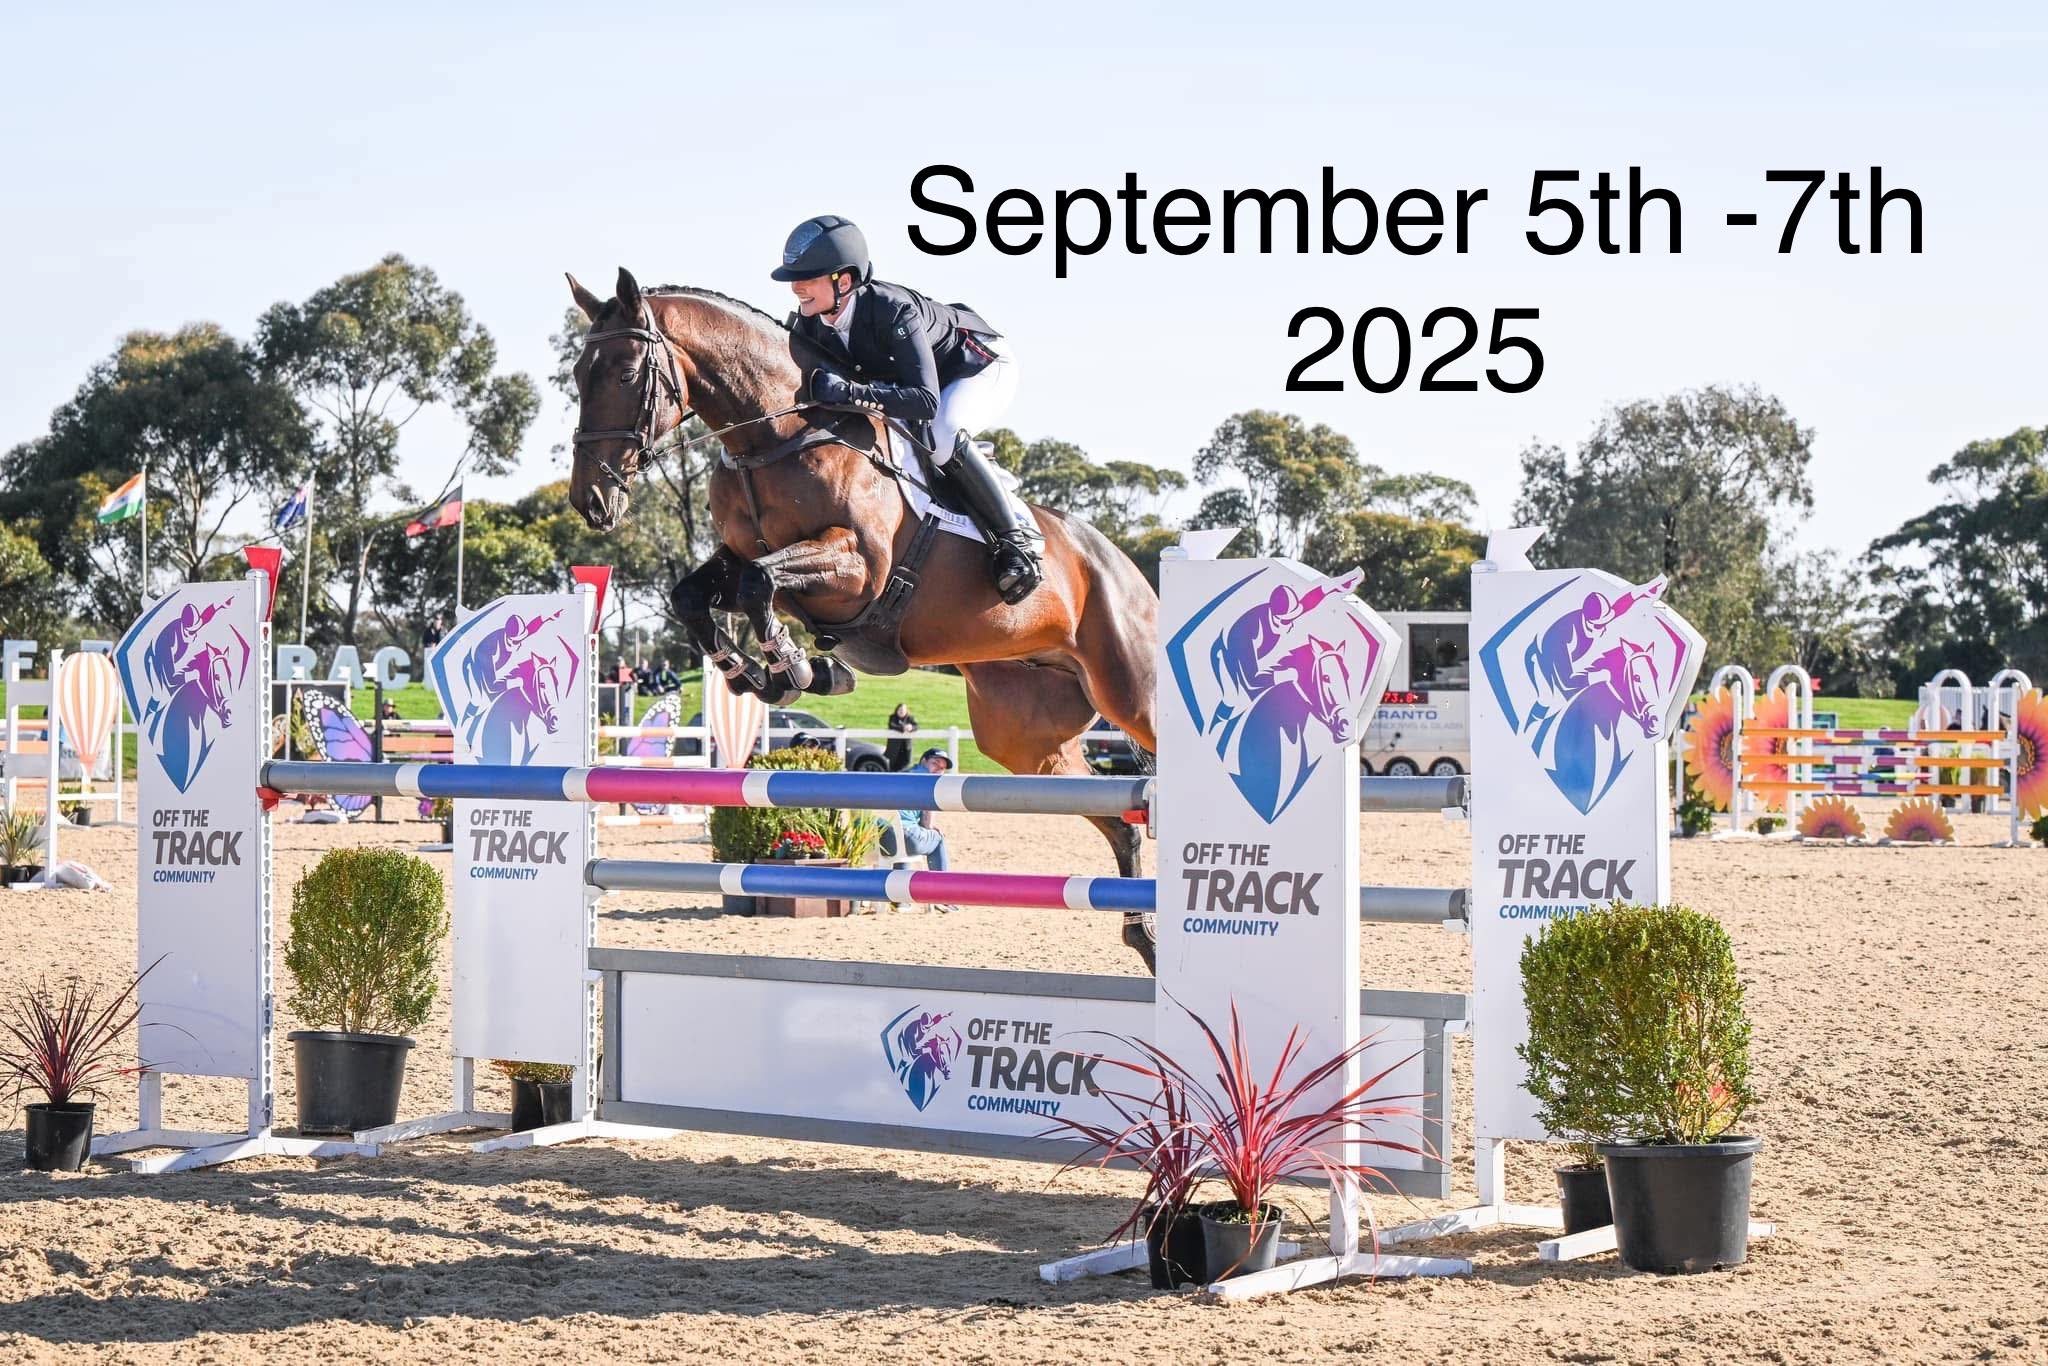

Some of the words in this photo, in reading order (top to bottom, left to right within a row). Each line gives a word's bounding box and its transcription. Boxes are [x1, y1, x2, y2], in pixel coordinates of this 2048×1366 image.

[1373, 710, 1438, 720] RANTO
[152, 809, 180, 828] OFF
[181, 809, 210, 828] THE
[470, 809, 501, 826] OFF
[502, 810, 533, 827] THE
[152, 830, 243, 866] TRACK
[469, 829, 570, 865] TRACK
[1182, 842, 1225, 865] OFF
[1227, 843, 1271, 867] THE
[1498, 834, 1541, 855] OFF
[1543, 834, 1586, 855] THE
[153, 869, 216, 884] COMMUNITY
[470, 866, 539, 881] COMMUNITY
[1498, 858, 1637, 901] TRACK
[1181, 868, 1324, 916] TRACK
[1499, 904, 1588, 920] COMMUNI
[1182, 917, 1279, 937] COMMUNITY
[967, 1017, 1009, 1042] OFF
[1011, 1020, 1053, 1046] THE
[966, 1045, 1104, 1098] TRACK
[967, 1094, 1061, 1117] COMMUNITY
